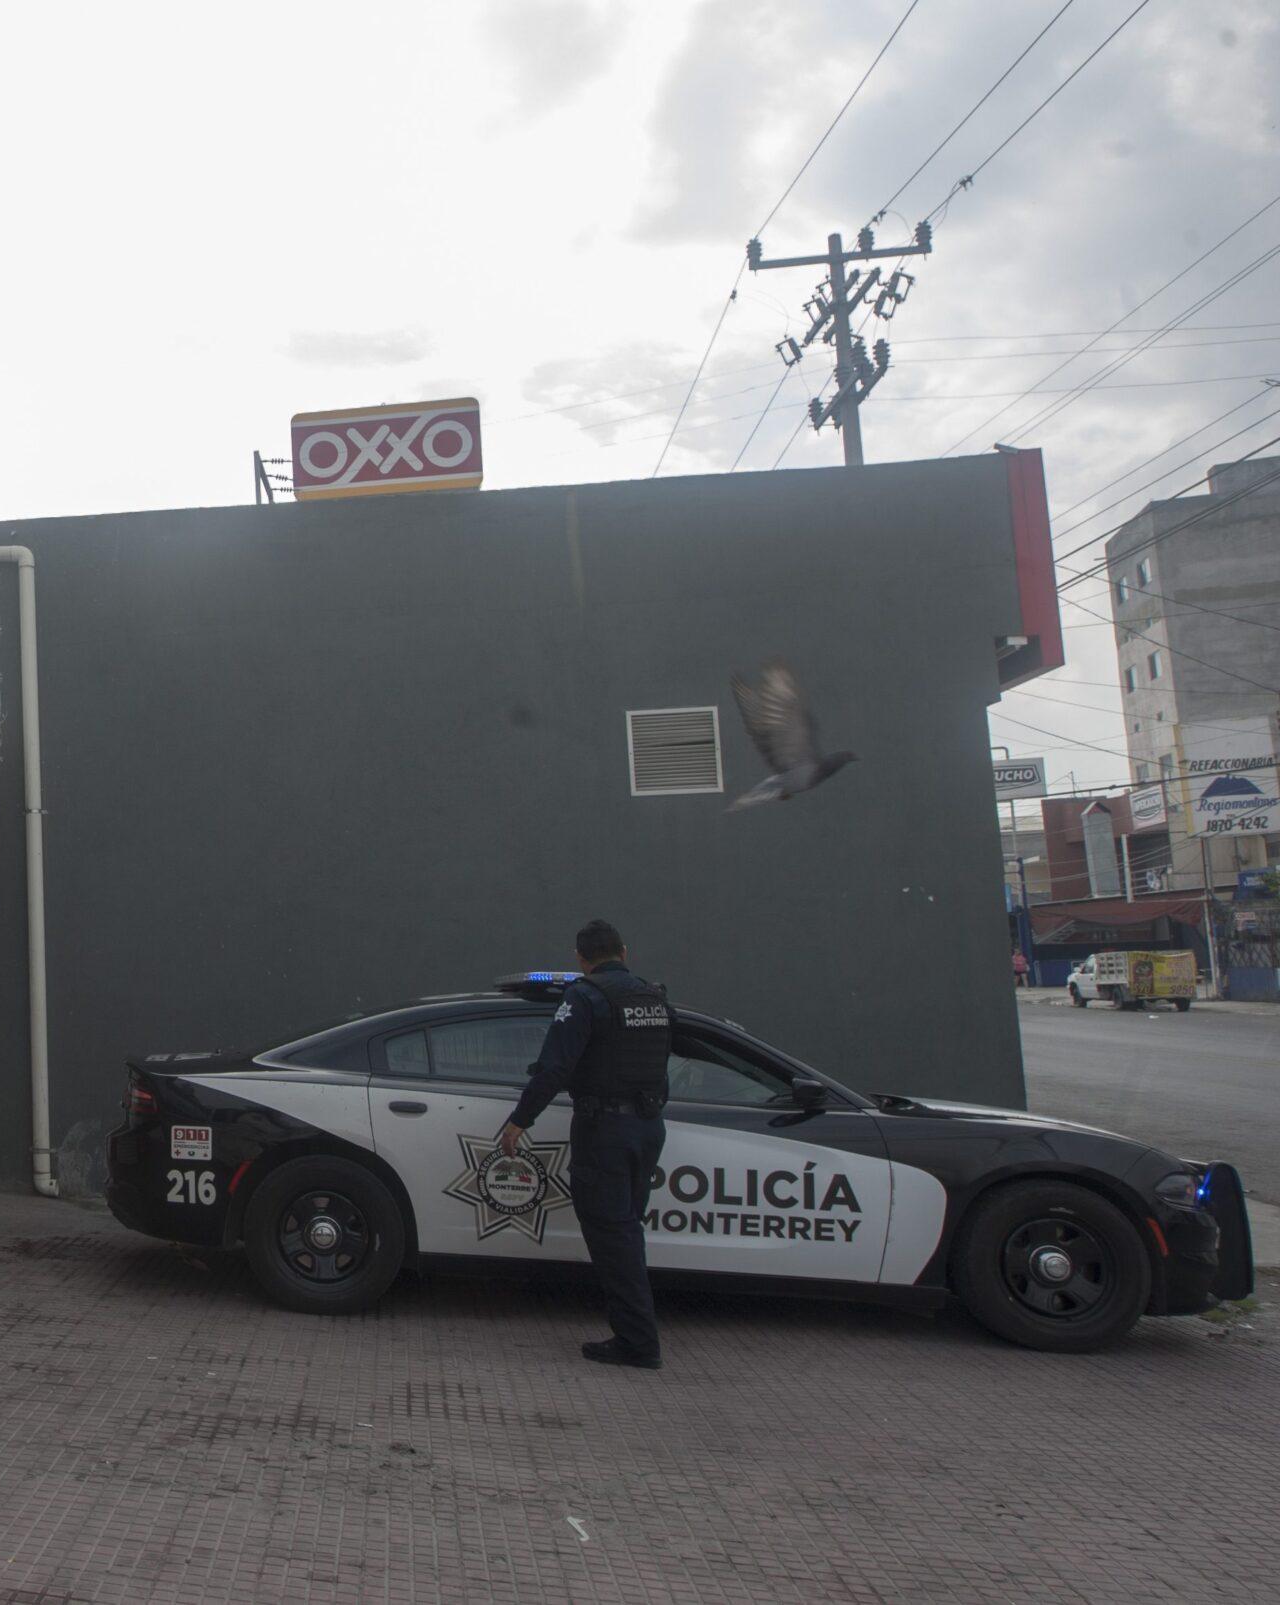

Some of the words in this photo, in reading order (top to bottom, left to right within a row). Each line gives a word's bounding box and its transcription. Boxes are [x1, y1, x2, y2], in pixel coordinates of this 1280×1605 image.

[299, 414, 473, 487] OXXO
[176, 1130, 206, 1140] 911
[166, 1168, 217, 1206] 216
